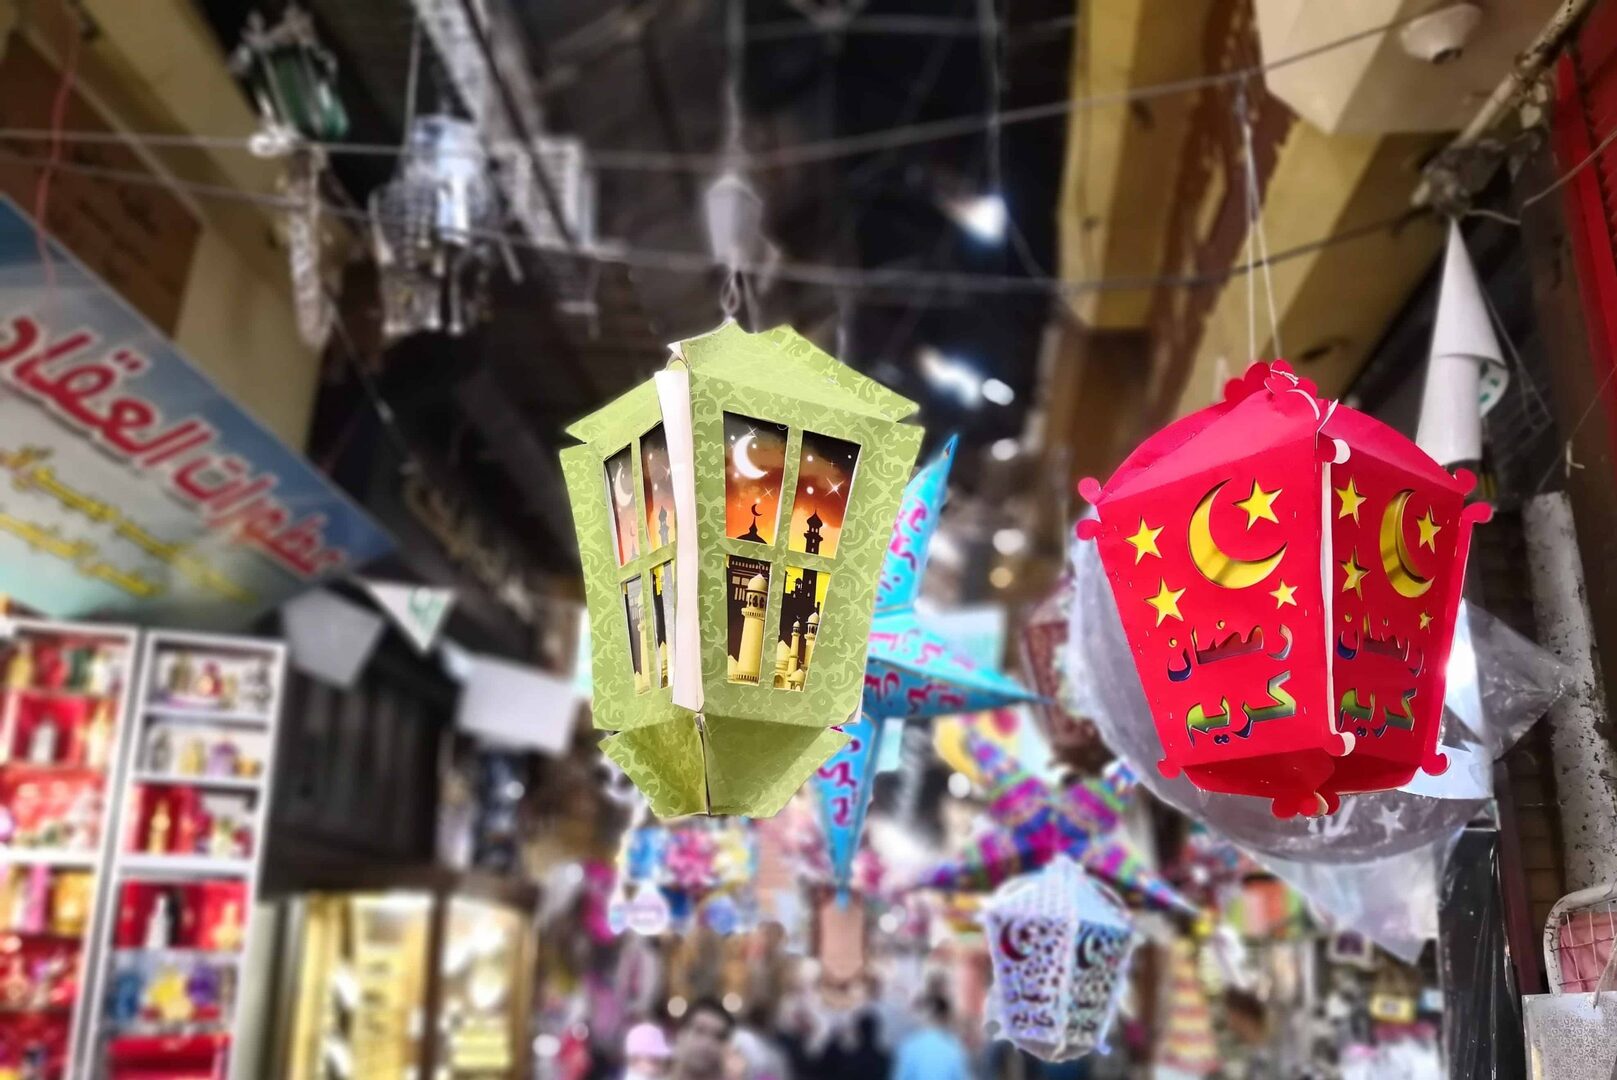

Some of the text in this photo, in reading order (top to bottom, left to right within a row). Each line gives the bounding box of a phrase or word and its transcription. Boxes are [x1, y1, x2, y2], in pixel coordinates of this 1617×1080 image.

[0, 315, 211, 468] العقاد
[1167, 620, 1293, 682] رمضان
[1337, 611, 1425, 678] رمضان
[1185, 670, 1296, 747] كريم
[1338, 688, 1418, 738] كريم
